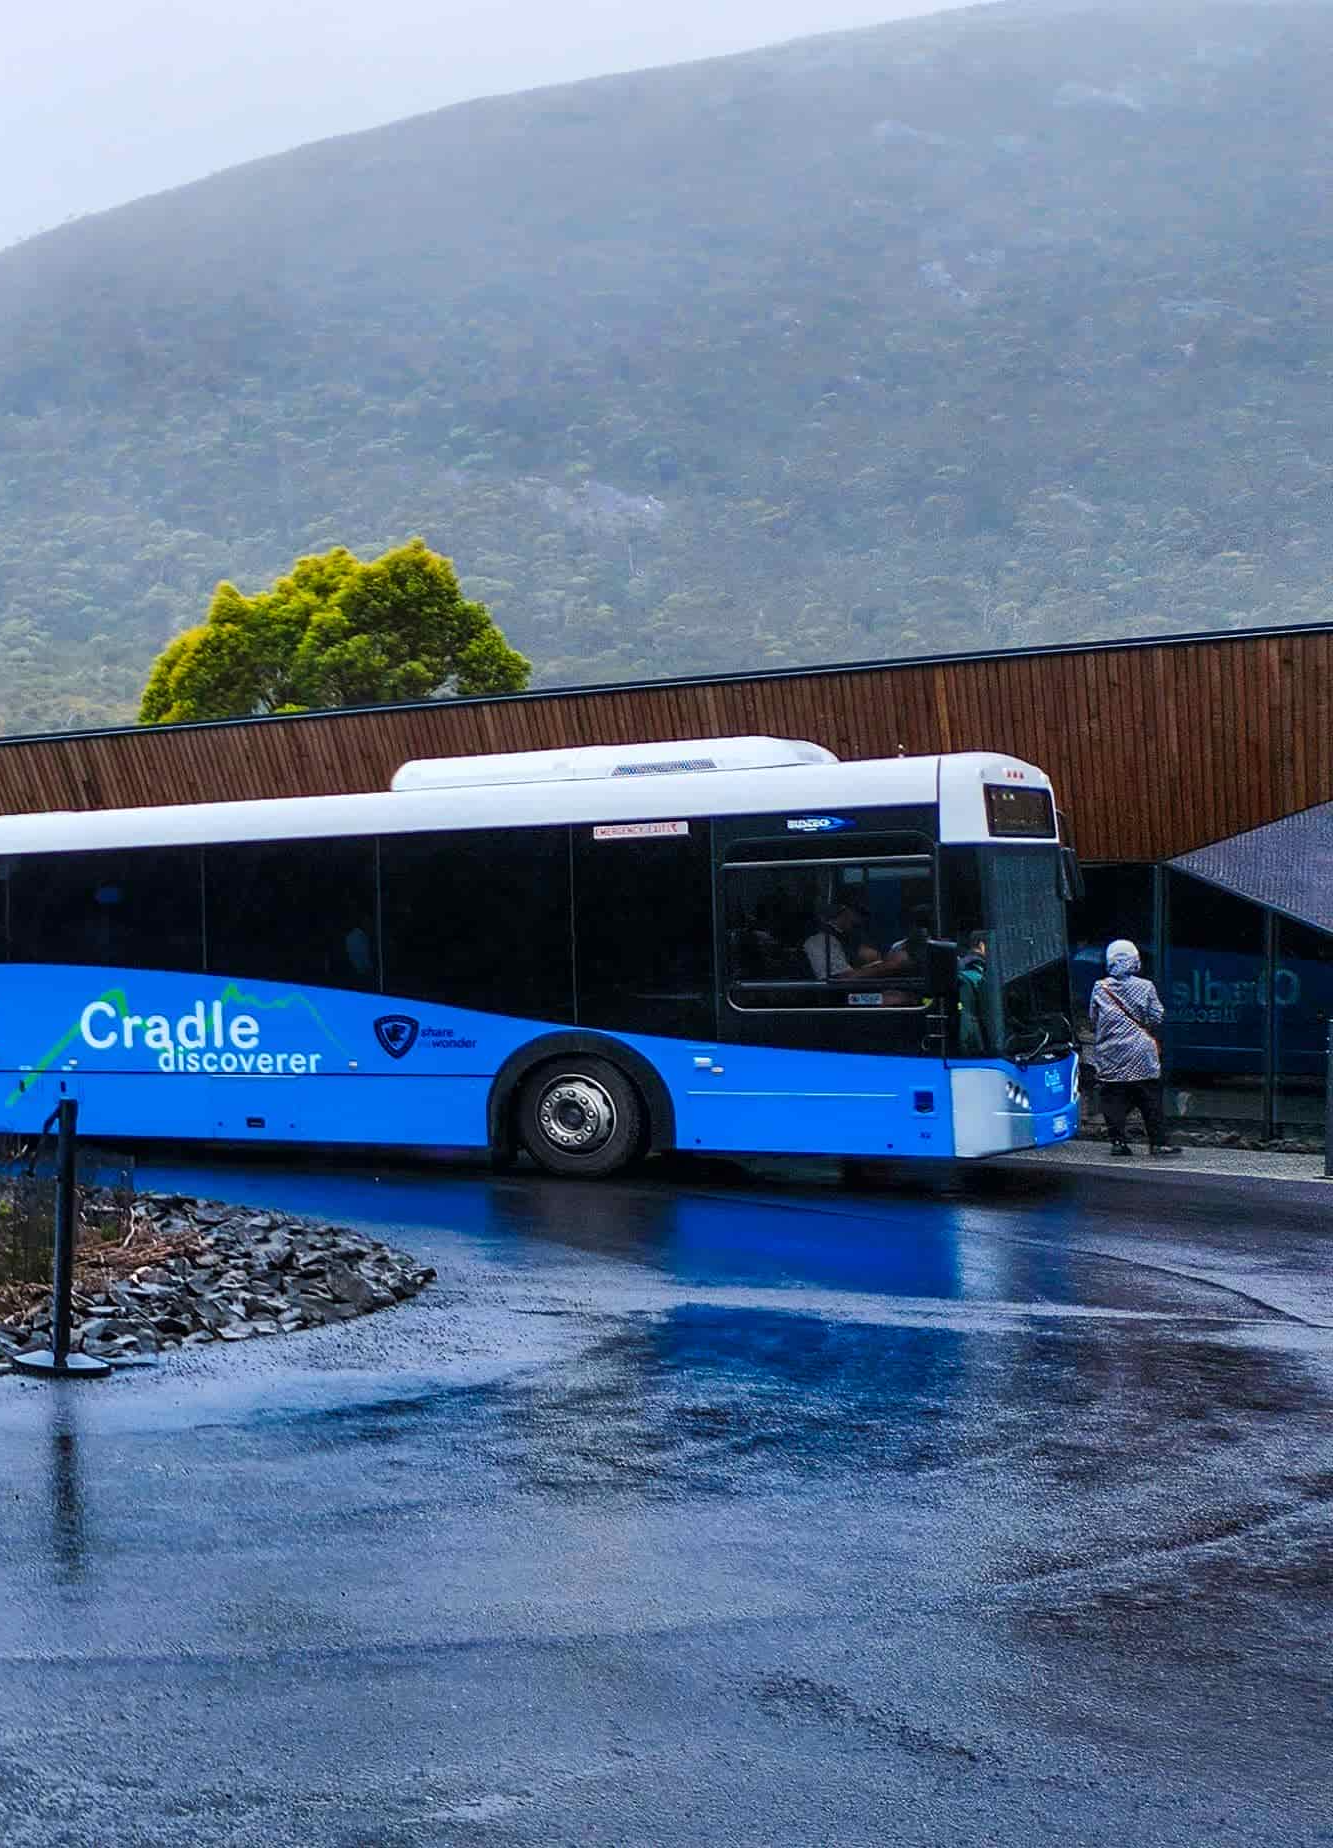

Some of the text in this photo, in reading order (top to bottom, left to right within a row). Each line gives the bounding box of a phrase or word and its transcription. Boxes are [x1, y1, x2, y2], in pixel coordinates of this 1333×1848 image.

[80, 999, 260, 1050] Cradle
[158, 1040, 322, 1074] discoverer
[432, 1037, 478, 1049] wonder
